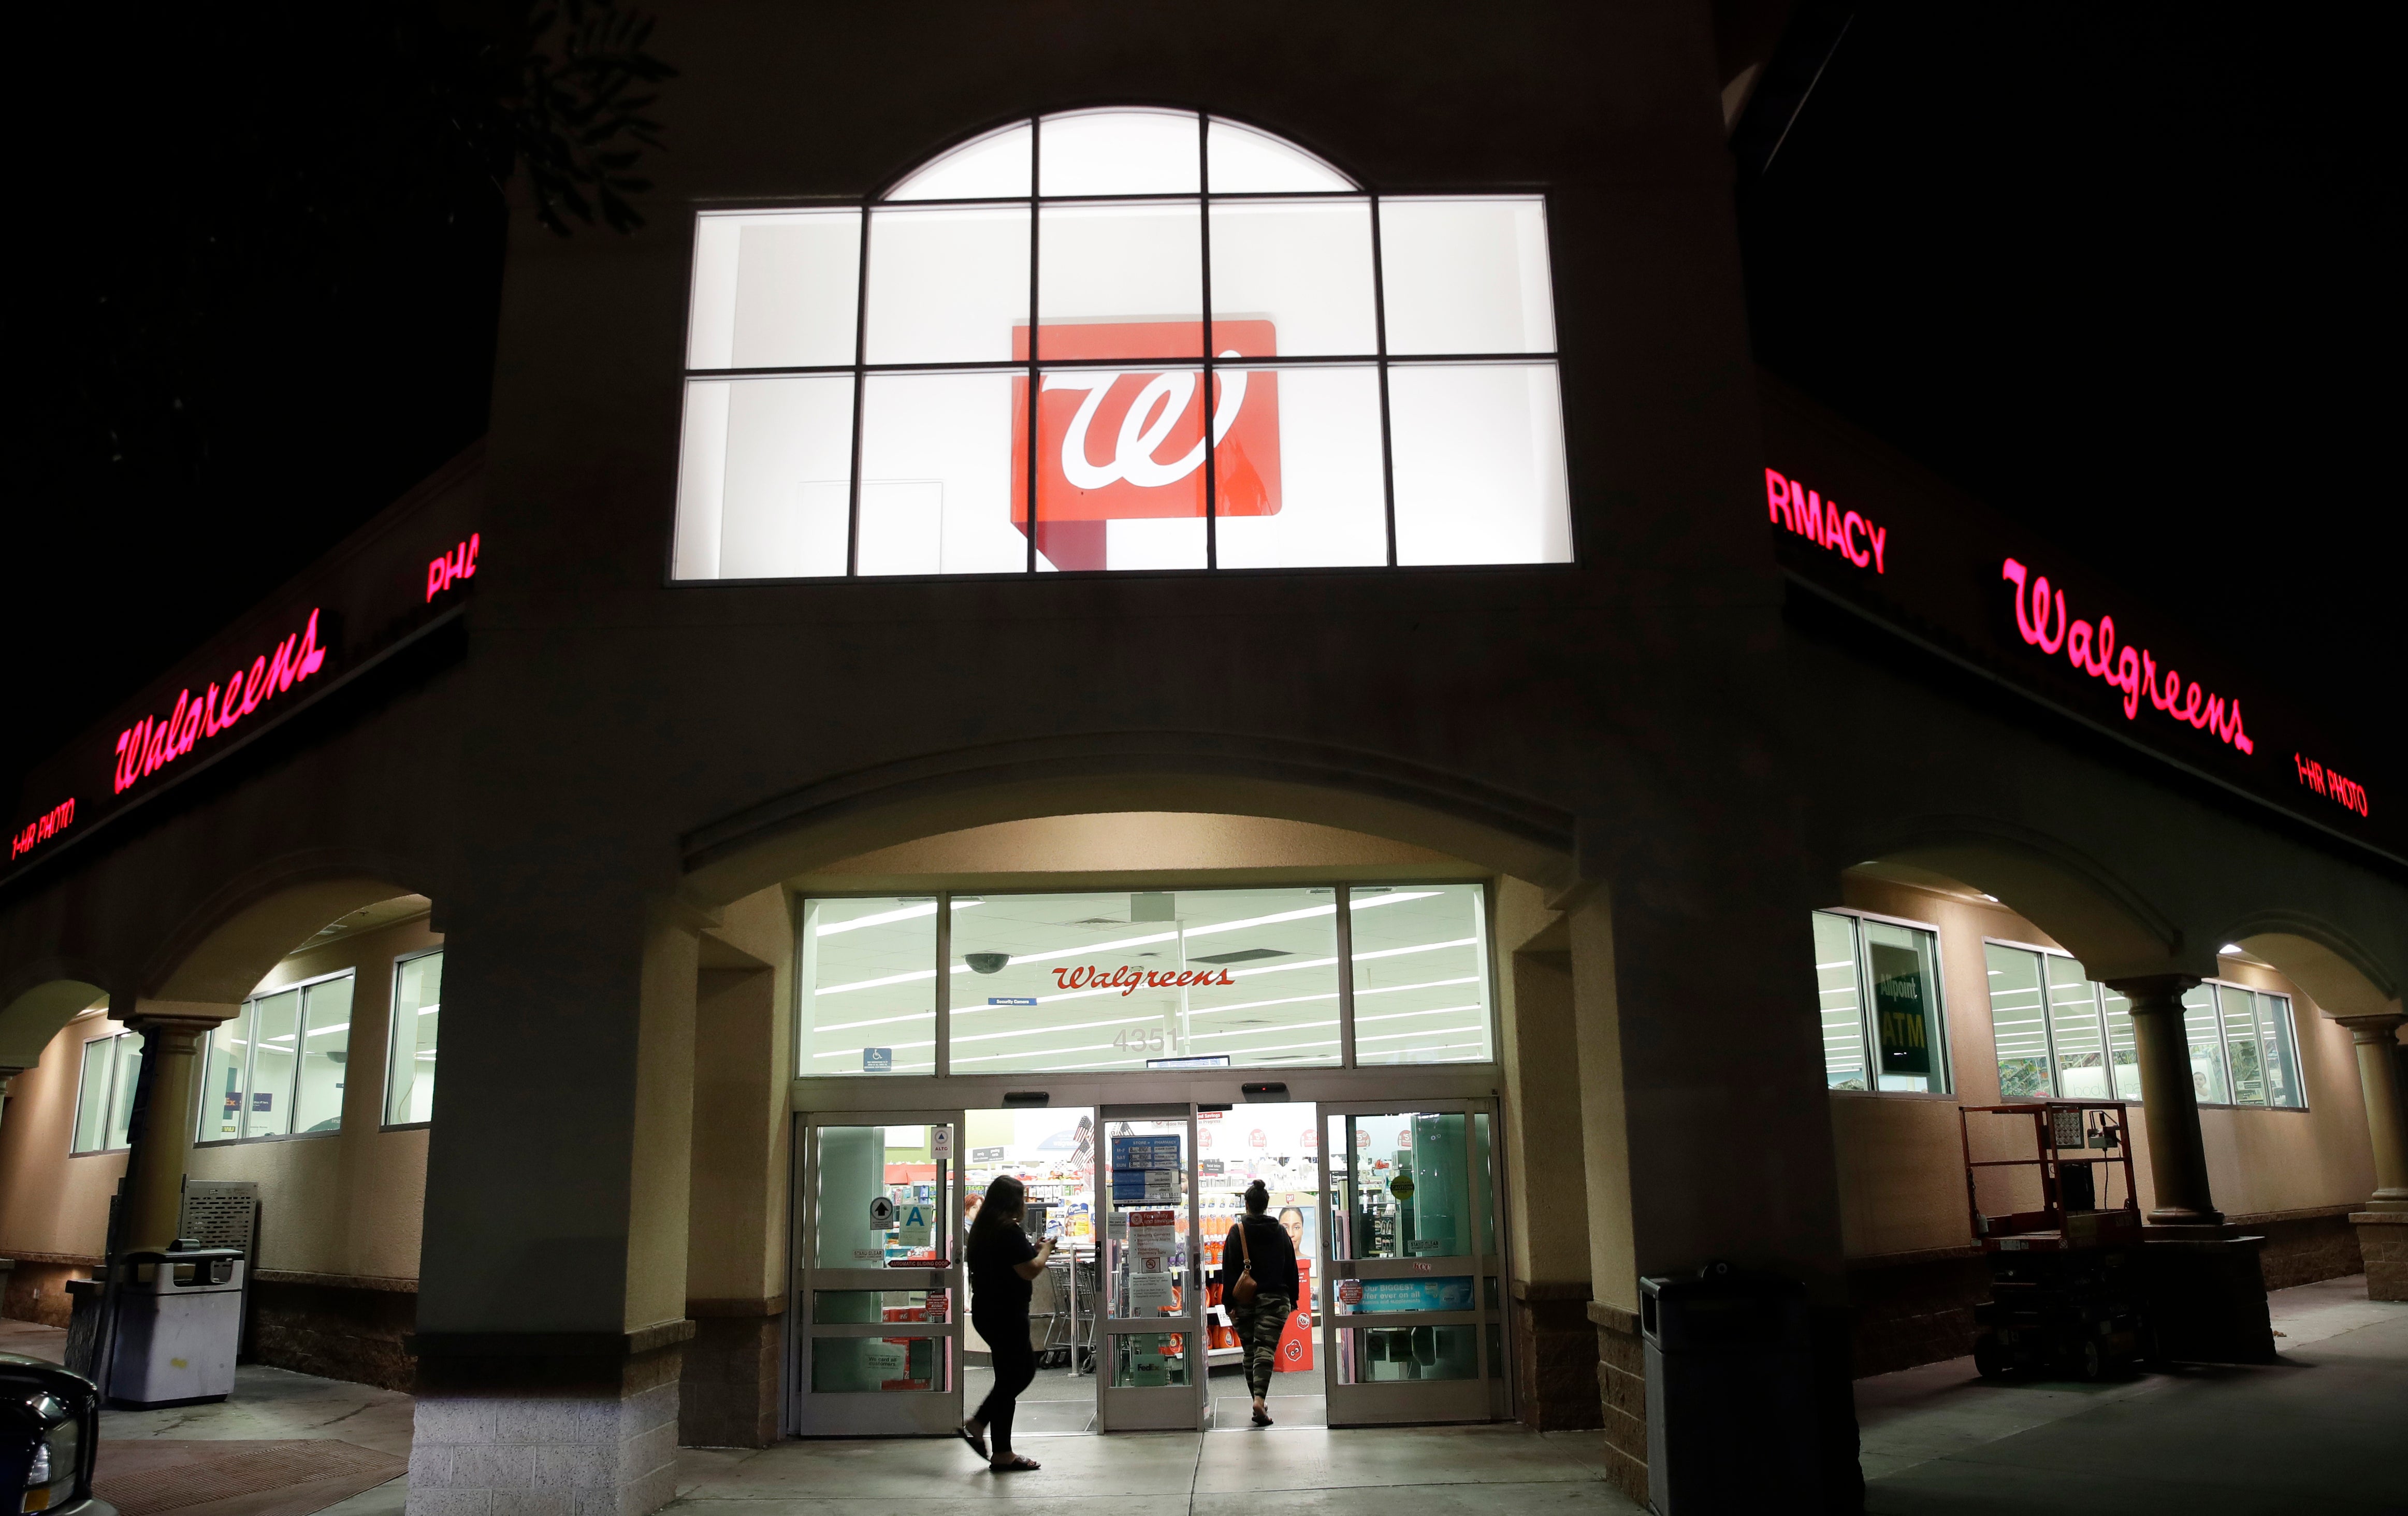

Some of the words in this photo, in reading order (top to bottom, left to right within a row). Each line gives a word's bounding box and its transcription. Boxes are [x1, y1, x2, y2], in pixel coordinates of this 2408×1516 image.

[1041, 349, 1249, 490] W
[2002, 557, 2254, 755] Walgreens
[114, 608, 327, 795] Walgreens
[2294, 752, 2326, 797] 1-HR
[2326, 769, 2369, 818] PHOTO
[12, 822, 37, 860] 1-HR
[37, 797, 75, 844] PHOTO
[1052, 965, 1236, 997] Walgreens
[1881, 973, 1917, 1002] Allpoint
[1113, 1028, 1177, 1052] 4351
[1882, 1011, 1925, 1048] ATM
[906, 1207, 925, 1226] A
